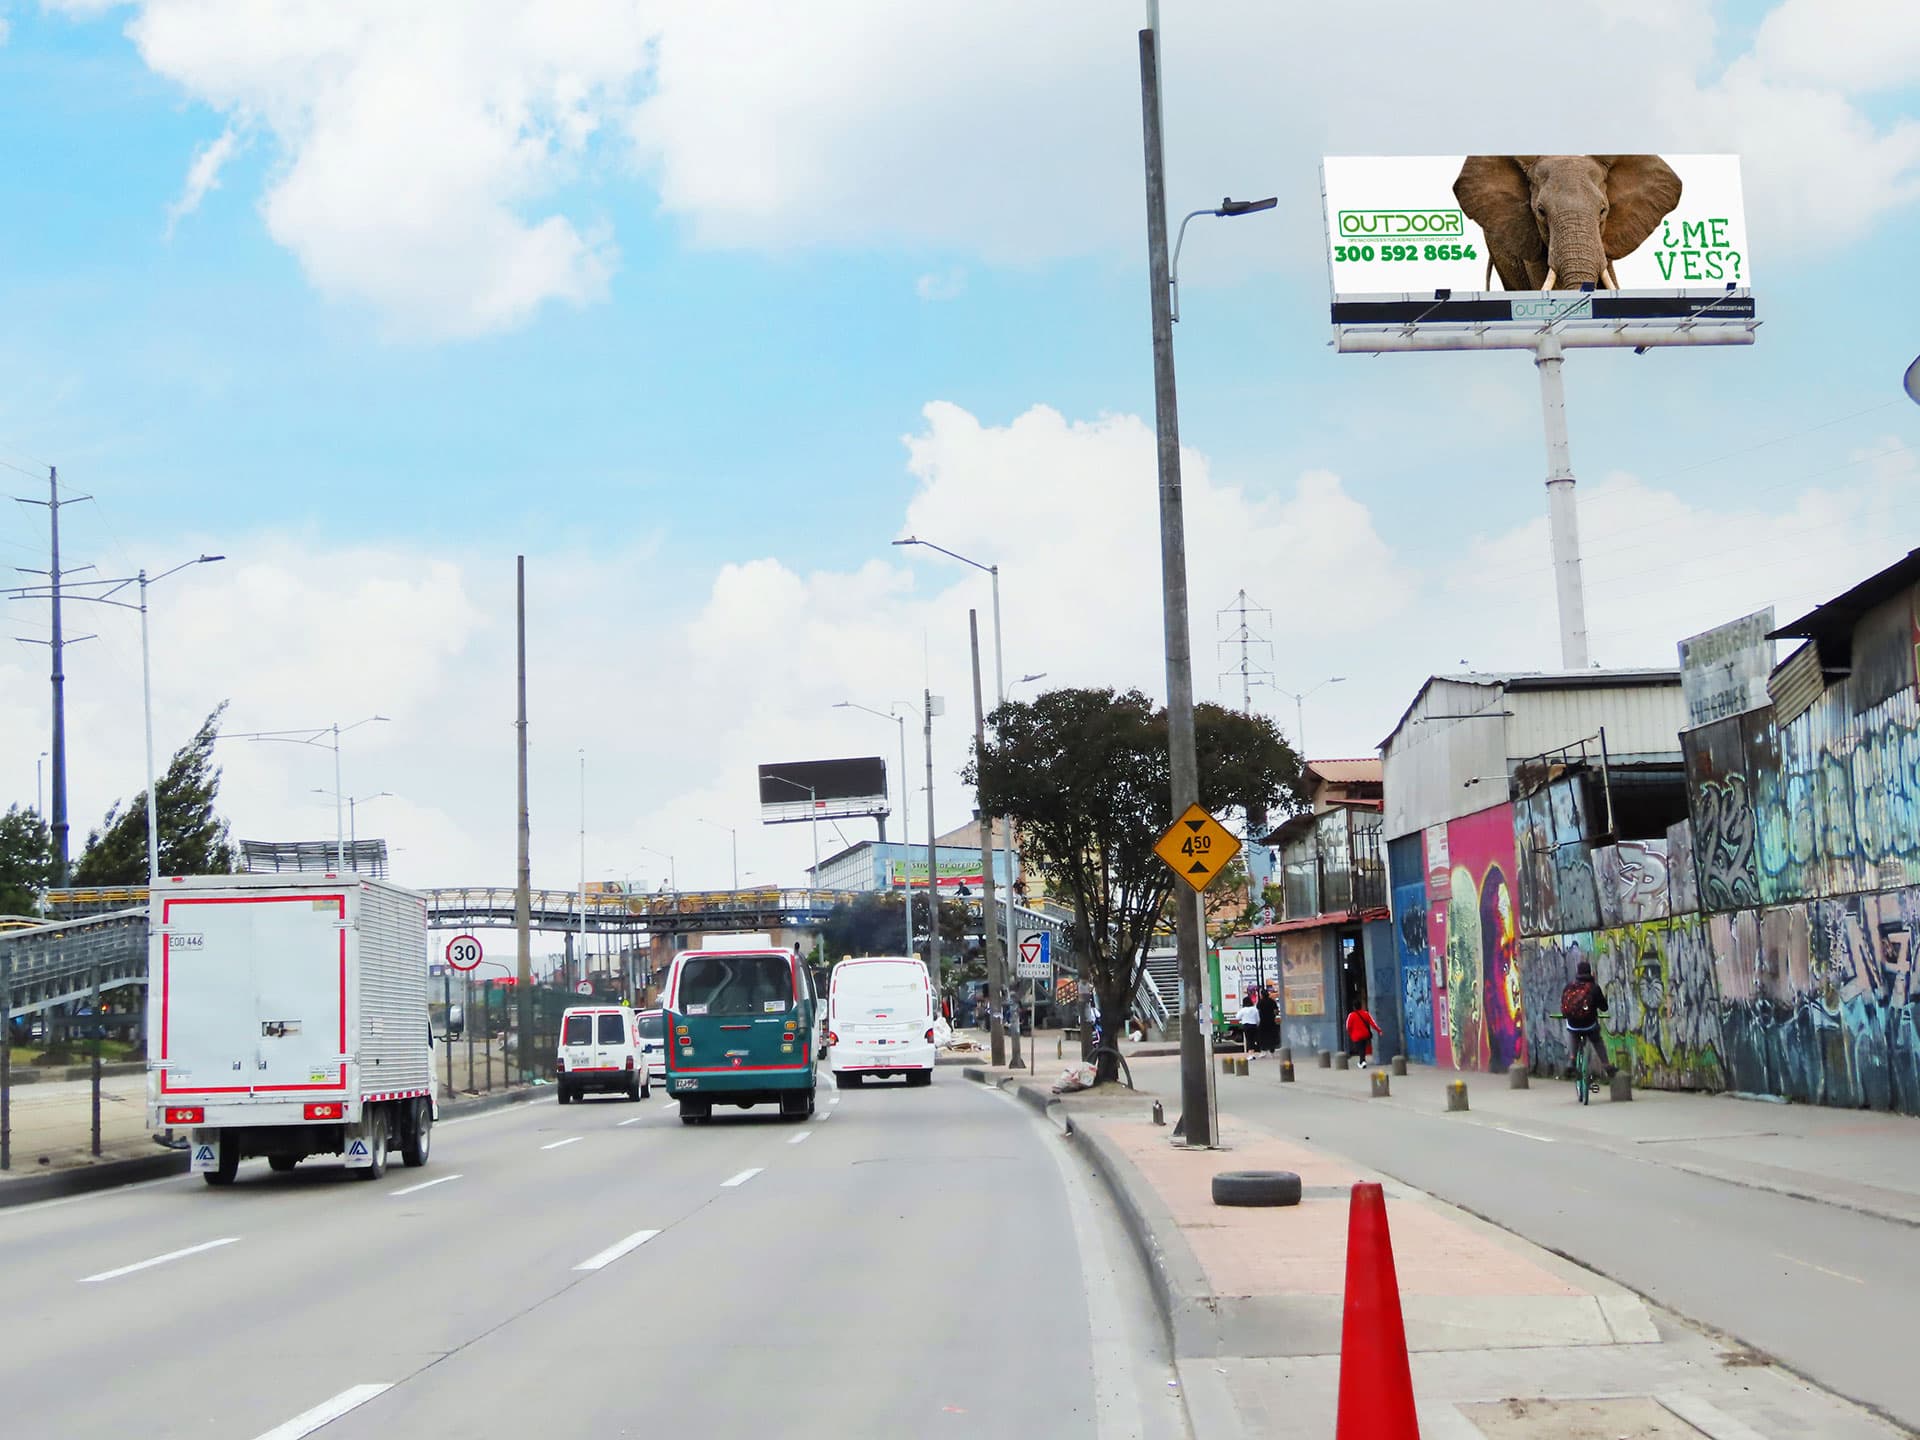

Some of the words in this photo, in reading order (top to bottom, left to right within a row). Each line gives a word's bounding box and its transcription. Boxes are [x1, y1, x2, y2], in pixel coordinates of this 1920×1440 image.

[1343, 214, 1459, 232] OUTDOOR
[1663, 218, 1730, 248] ¿ME
[1334, 245, 1375, 262] 300
[1381, 245, 1418, 261] 592
[1424, 244, 1477, 261] 8654
[1654, 250, 1741, 280] VES?
[454, 945, 476, 961] 30
